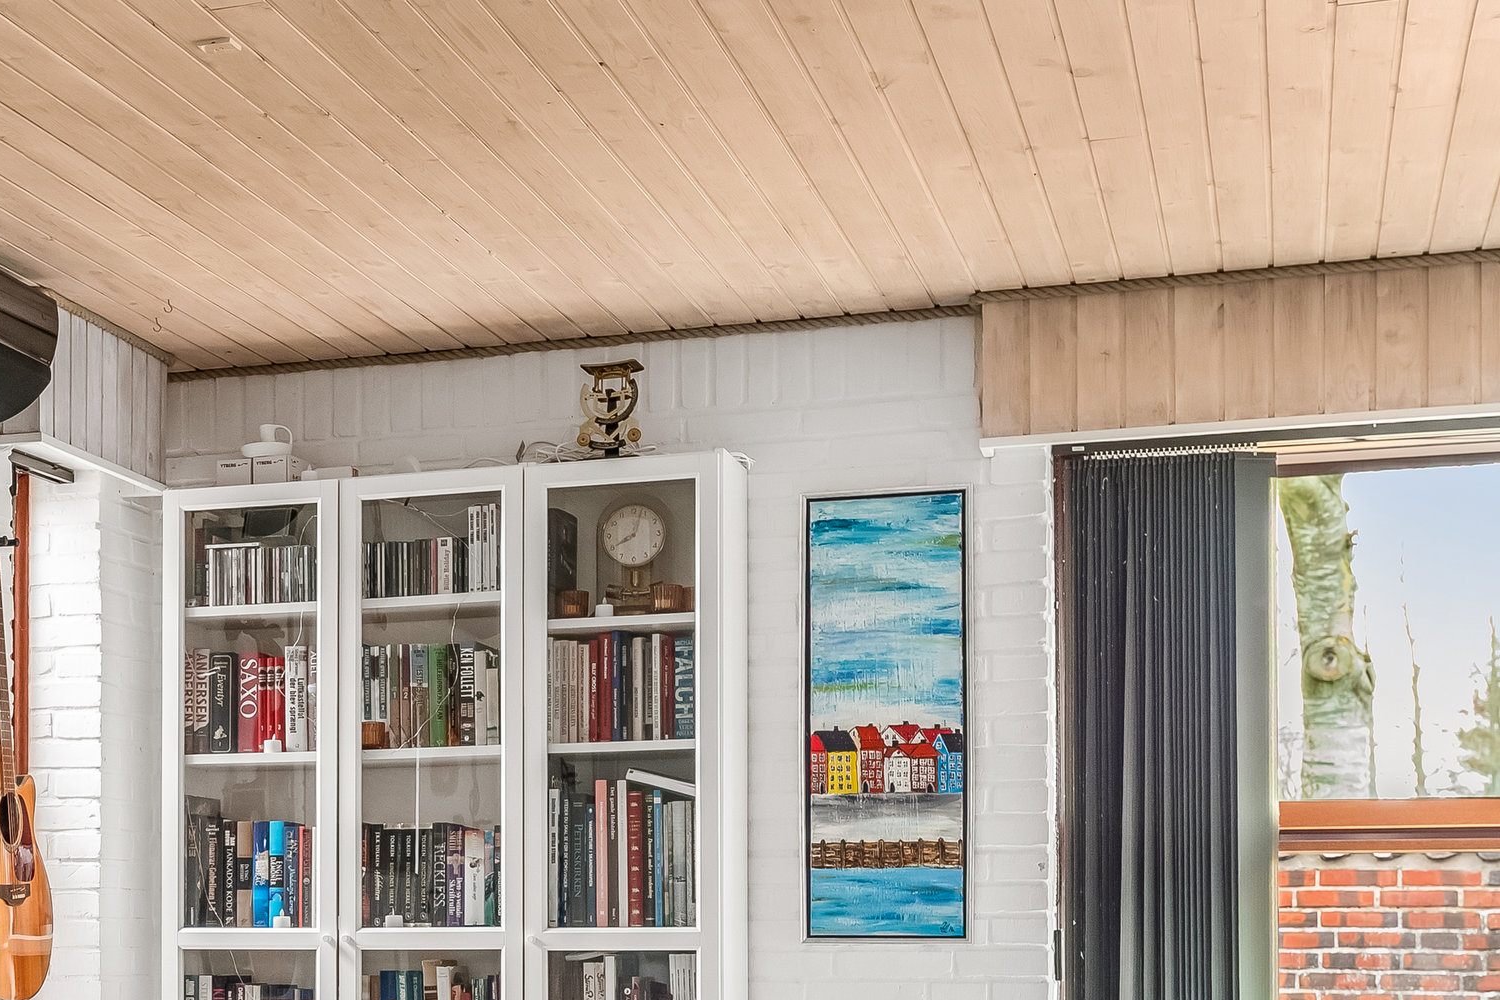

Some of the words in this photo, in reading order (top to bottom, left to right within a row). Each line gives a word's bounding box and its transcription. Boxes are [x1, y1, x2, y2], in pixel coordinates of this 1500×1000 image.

[460, 648, 473, 664] KEN
[214, 673, 227, 707] Eventyr
[240, 658, 258, 719] SAXO
[460, 666, 473, 698] FOLLETT
[675, 645, 693, 719] FALCH
[226, 847, 234, 889] TANKADOS
[433, 842, 446, 907] RECKLESS
[574, 823, 584, 898] PETERSKIRKEN
[226, 890, 234, 912] KODE
